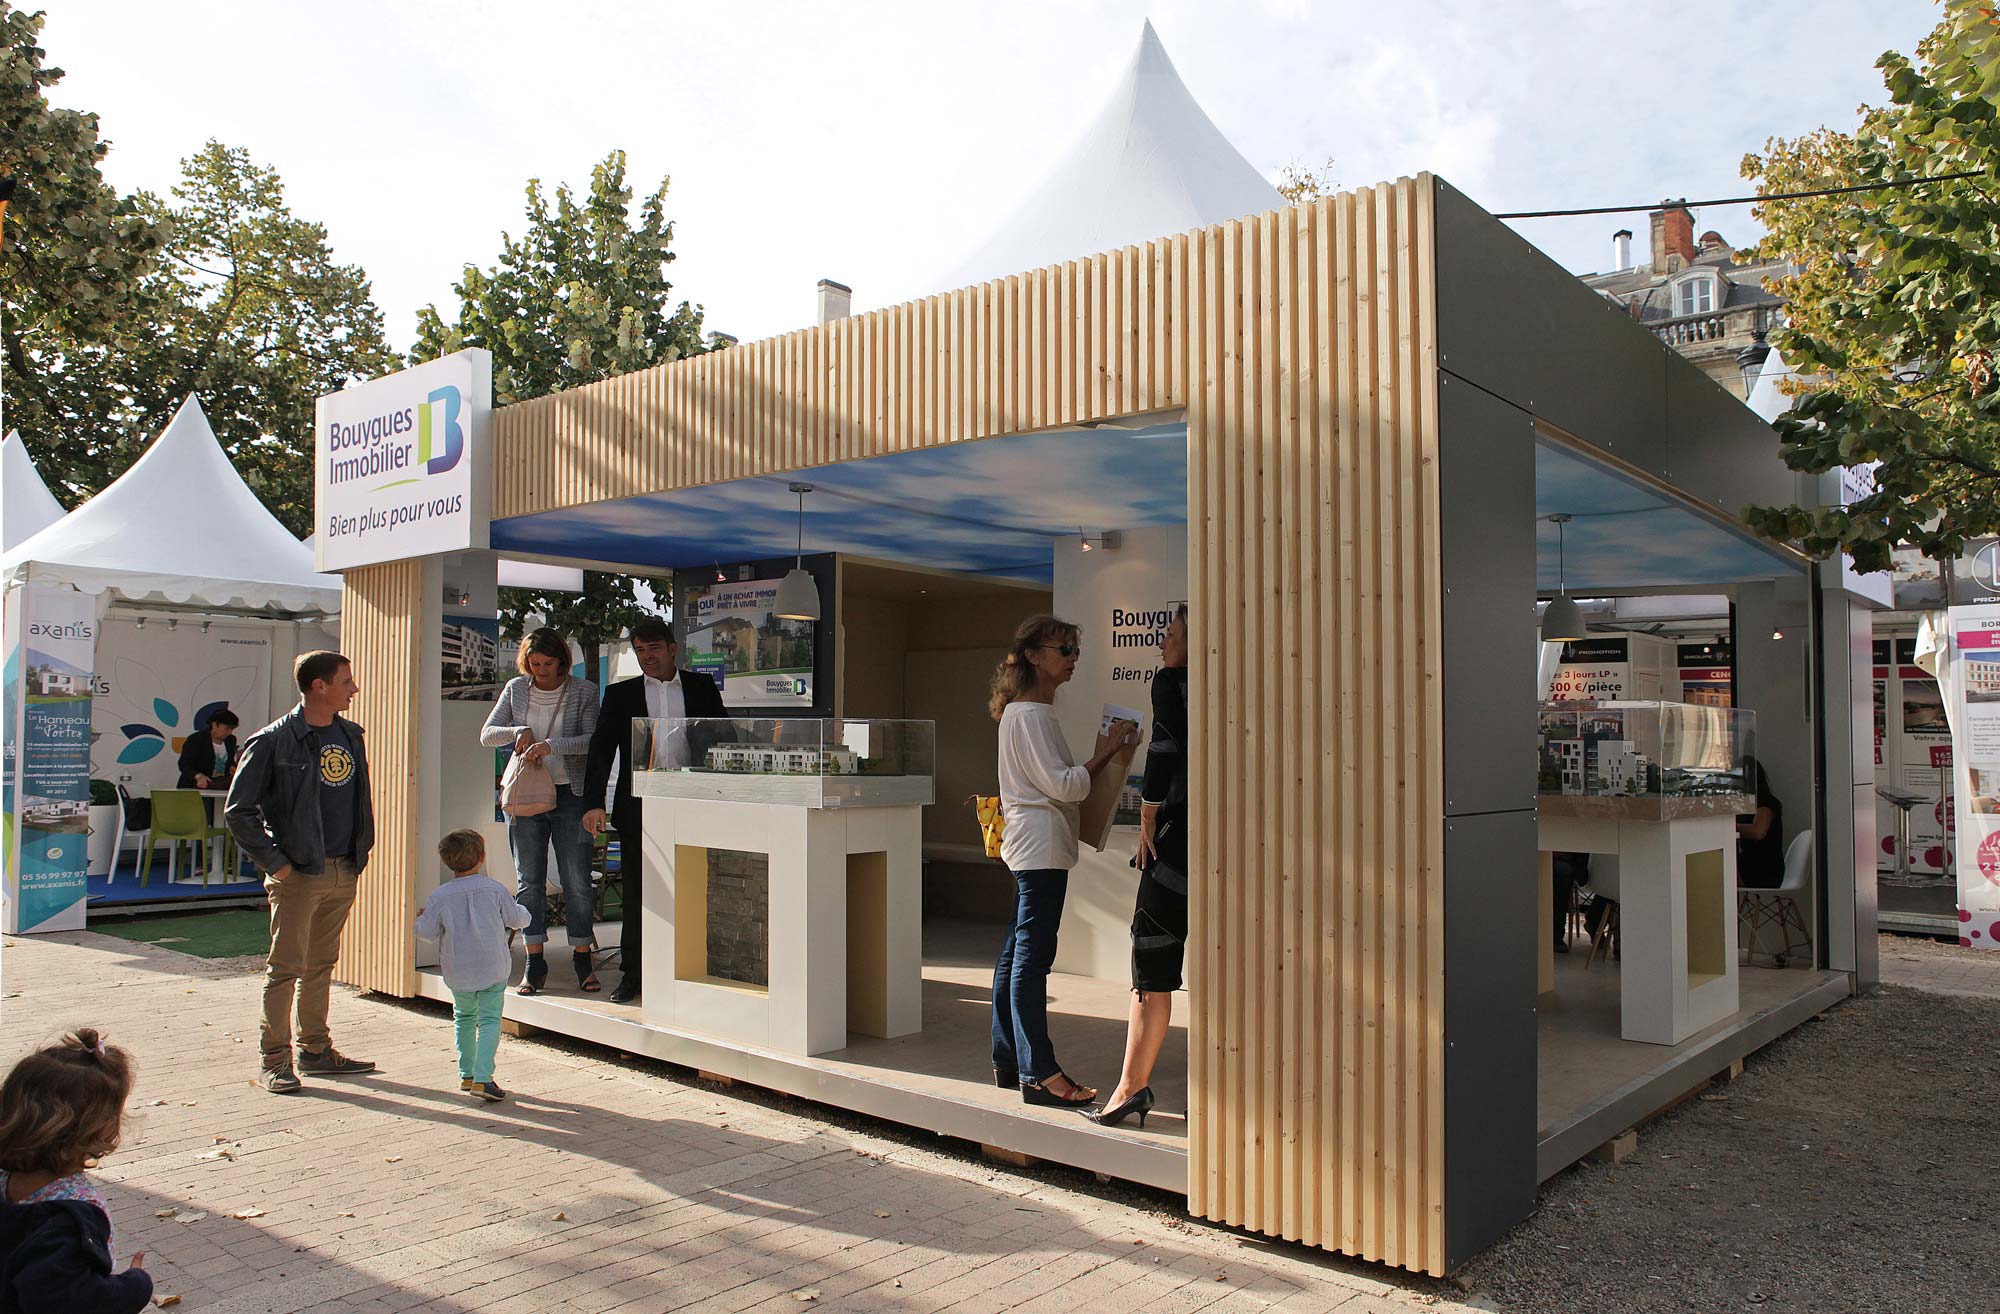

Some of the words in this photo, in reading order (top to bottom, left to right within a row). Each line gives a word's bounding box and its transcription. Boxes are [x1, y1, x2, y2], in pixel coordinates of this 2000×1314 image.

[330, 407, 412, 451] Bouygues
[330, 443, 412, 485] Immobilier
[329, 516, 356, 537] Bien
[359, 507, 387, 537] plus
[390, 503, 424, 531] pour
[428, 494, 462, 518] vous
[723, 593, 733, 601] UN
[733, 591, 753, 600] ACHAT
[699, 599, 714, 610] OUI
[739, 600, 757, 608] VIVRE
[30, 621, 92, 639] axanis
[220, 638, 268, 646] www.axanis.fr
[1112, 667, 1141, 681] Bien
[1573, 671, 1597, 680] jours
[766, 679, 792, 687] Bouygues
[1575, 681, 1622, 694] €/pièce
[766, 686, 792, 694] Immobilier
[38, 715, 90, 725] Hameau
[22, 873, 34, 881] 05
[34, 872, 47, 881] 56
[48, 872, 60, 880] 99
[61, 871, 73, 879] 97
[74, 870, 86, 878] 97
[21, 879, 86, 890] www.axanis.fr
